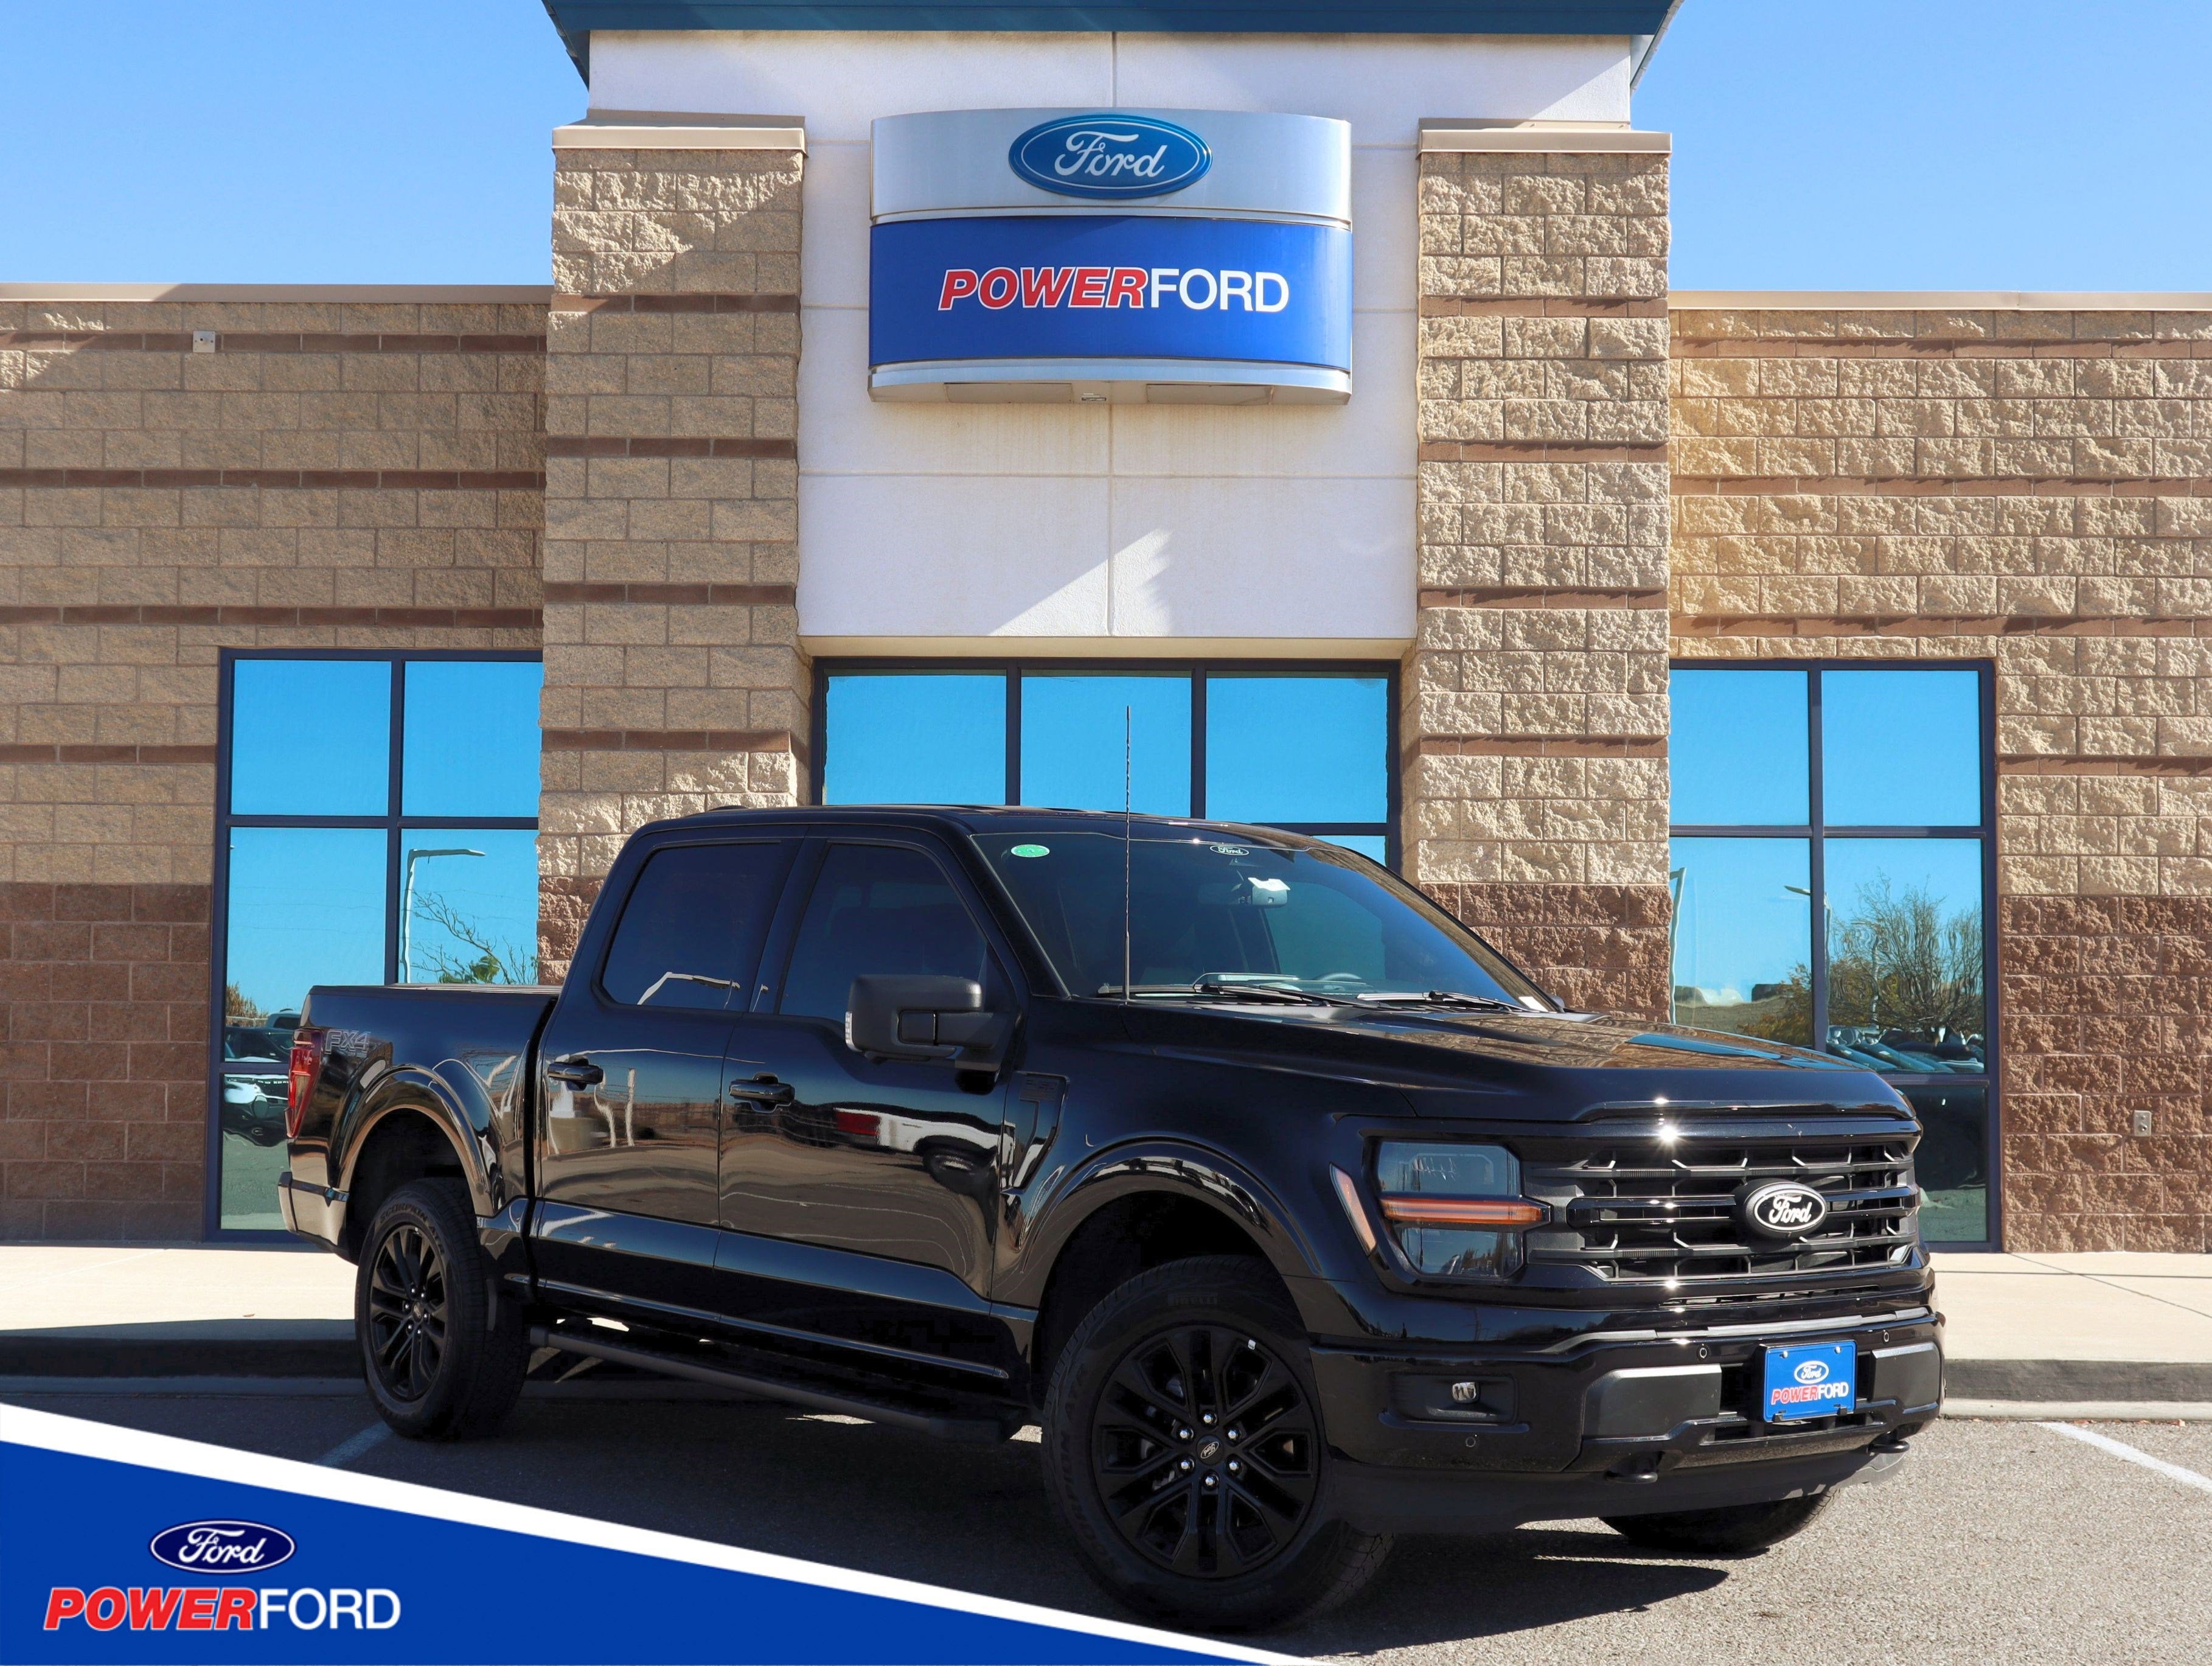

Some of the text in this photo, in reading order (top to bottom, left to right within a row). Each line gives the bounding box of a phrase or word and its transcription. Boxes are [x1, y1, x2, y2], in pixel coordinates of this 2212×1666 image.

[1055, 130, 1166, 179] Ford
[324, 1028, 371, 1054] FX4
[1769, 1195, 1812, 1224] Ford
[1801, 1364, 1822, 1379] Ford
